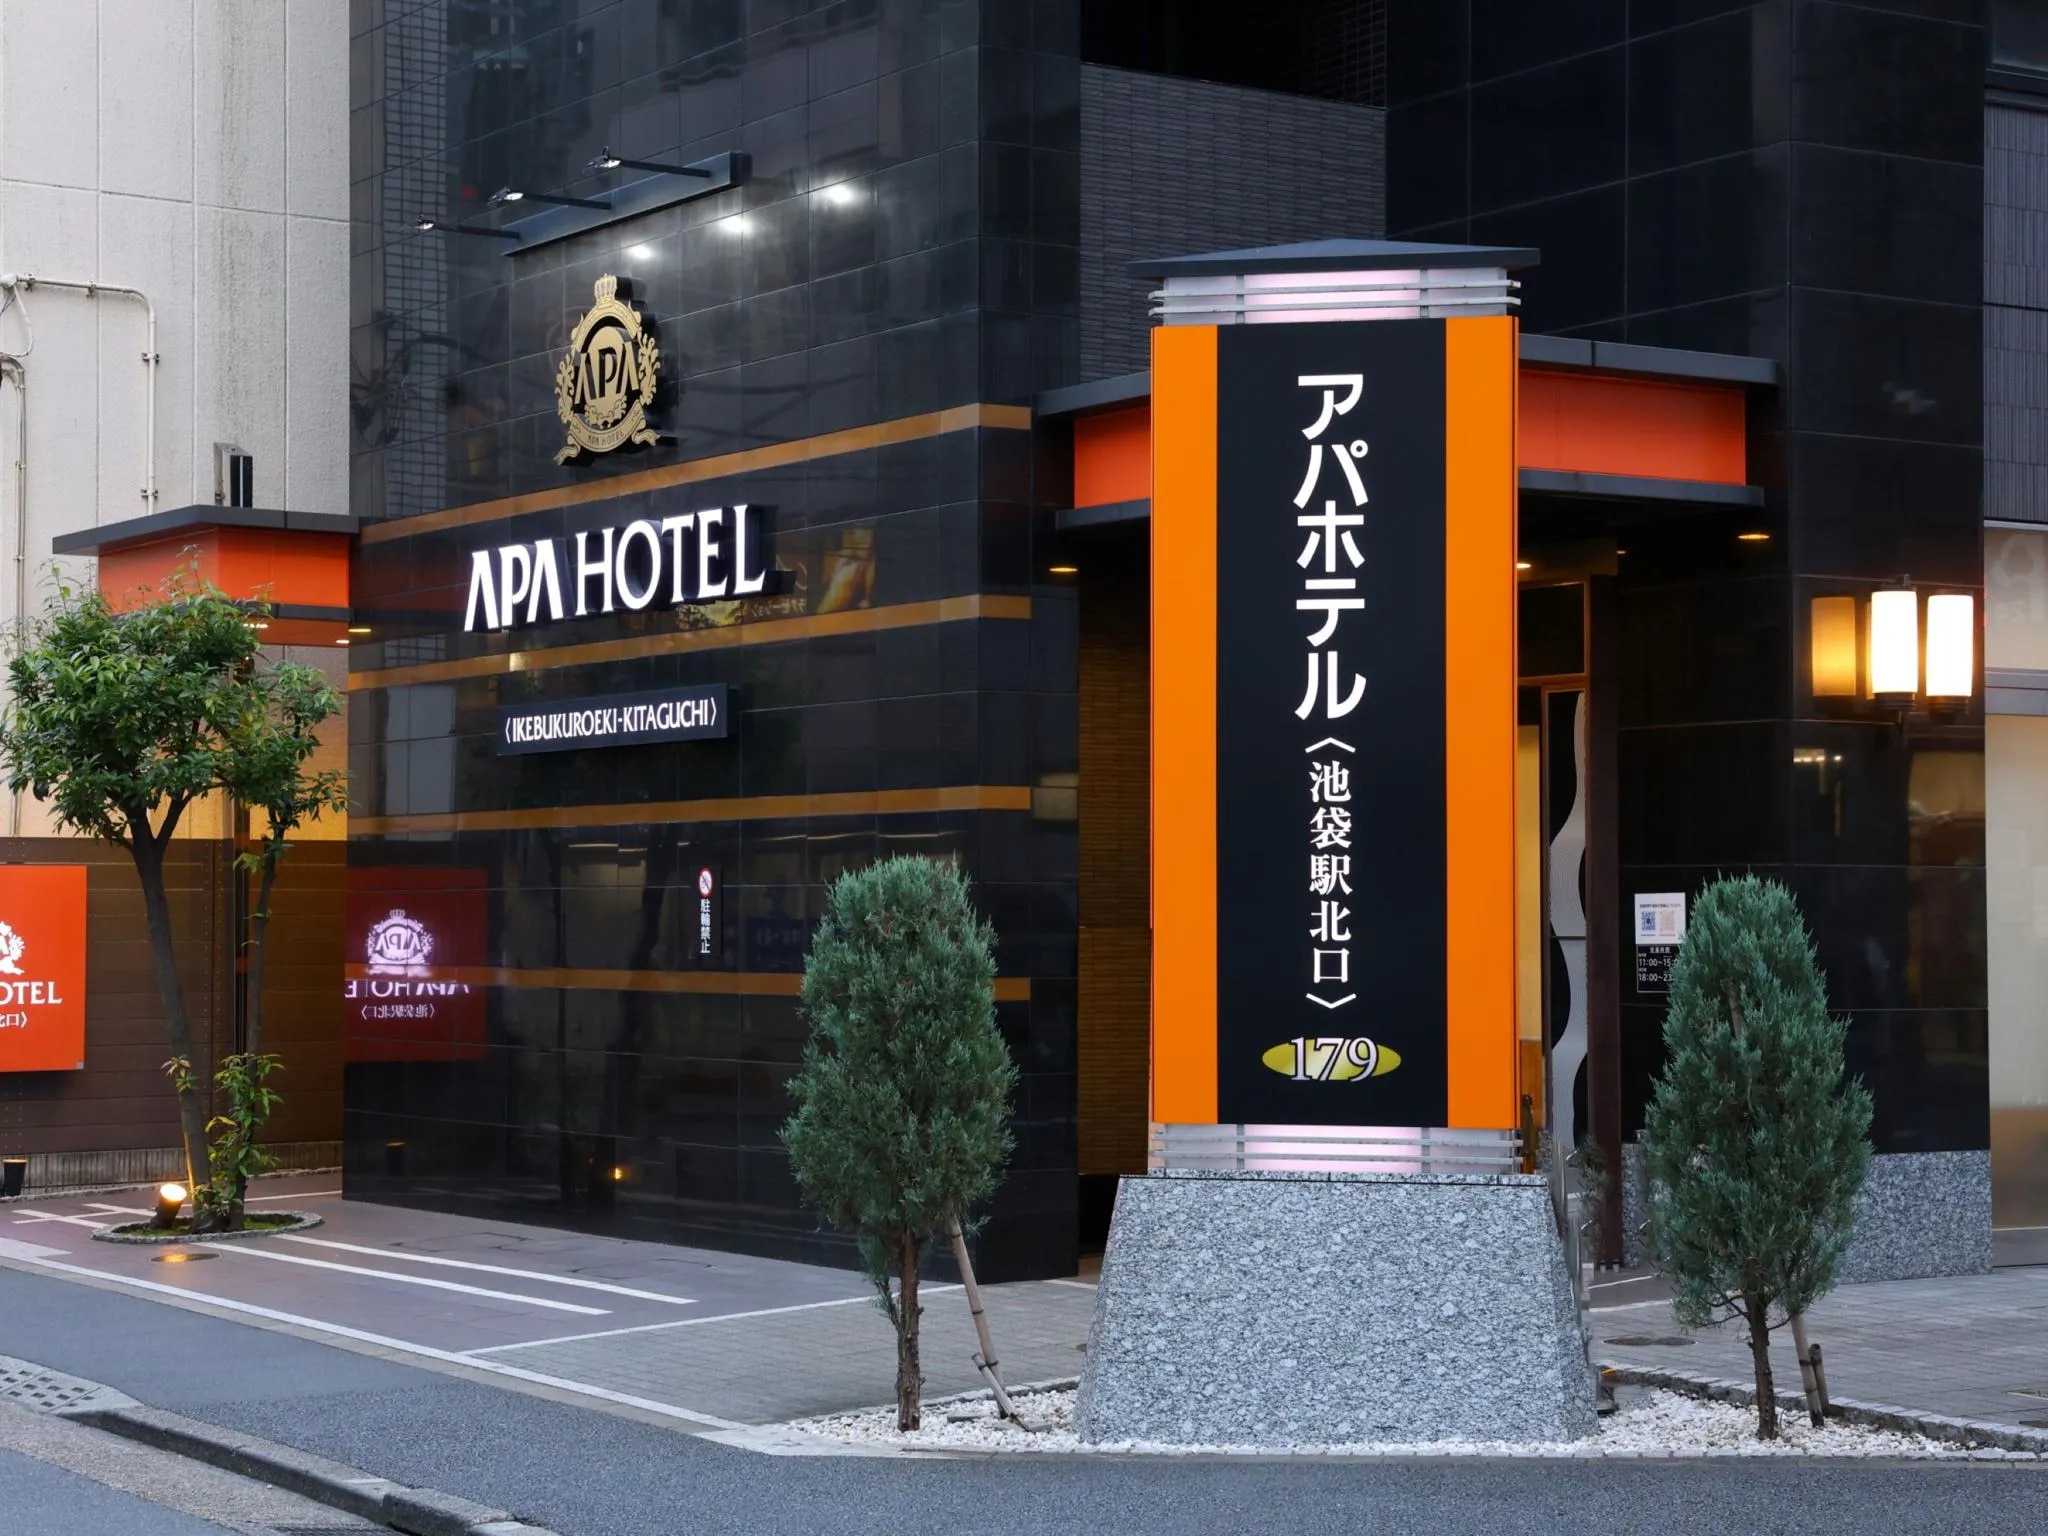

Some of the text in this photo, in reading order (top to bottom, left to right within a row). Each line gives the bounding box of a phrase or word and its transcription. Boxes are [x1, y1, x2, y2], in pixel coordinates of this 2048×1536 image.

[574, 341, 640, 405] APA
[464, 504, 766, 632] APA HOTEL
[1293, 373, 1369, 721] アパホテル
[1289, 1036, 1380, 1082] 179
